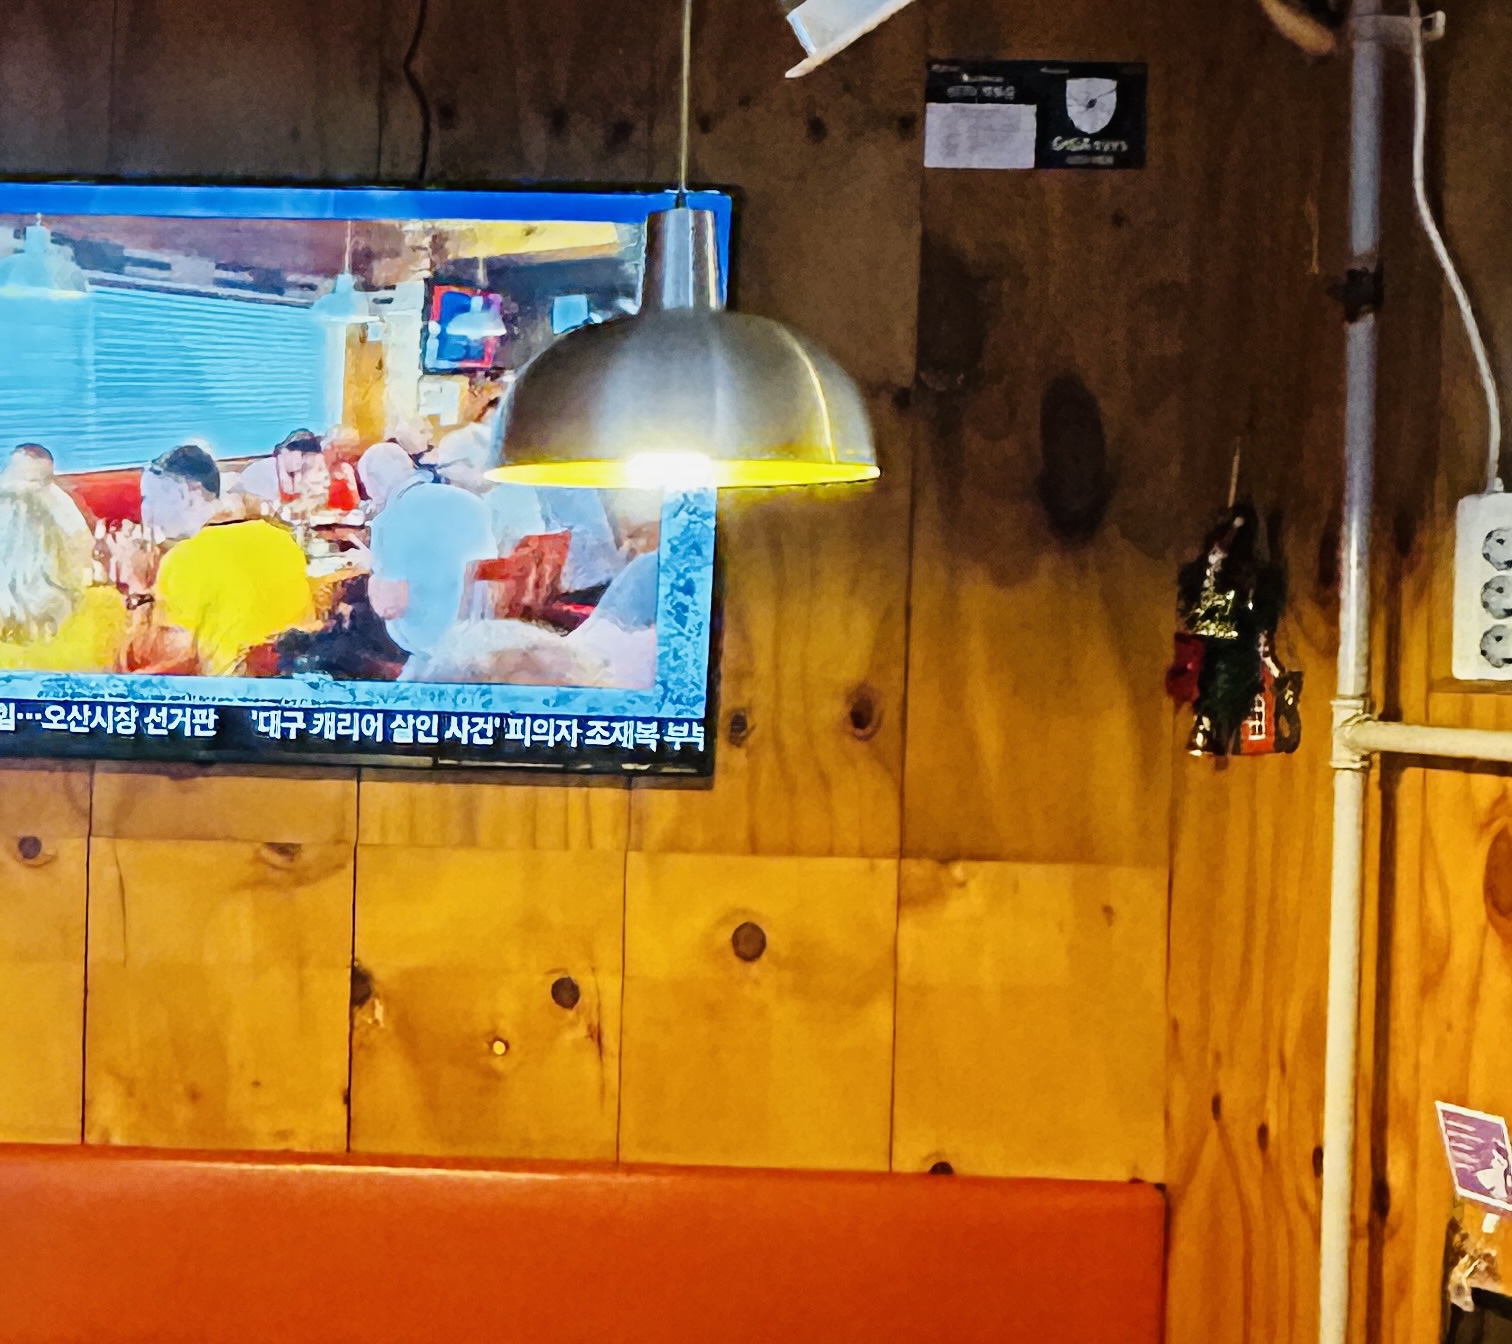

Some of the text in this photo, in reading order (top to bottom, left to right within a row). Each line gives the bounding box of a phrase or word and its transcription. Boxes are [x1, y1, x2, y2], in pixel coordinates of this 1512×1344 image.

[143, 707, 219, 737] 선거판
[251, 709, 306, 740] '대구
[312, 711, 384, 743] 캐리어
[389, 713, 439, 744] 살인
[444, 715, 501, 745] 사건'
[504, 716, 584, 748] 피의자
[584, 720, 661, 753] 조재복
